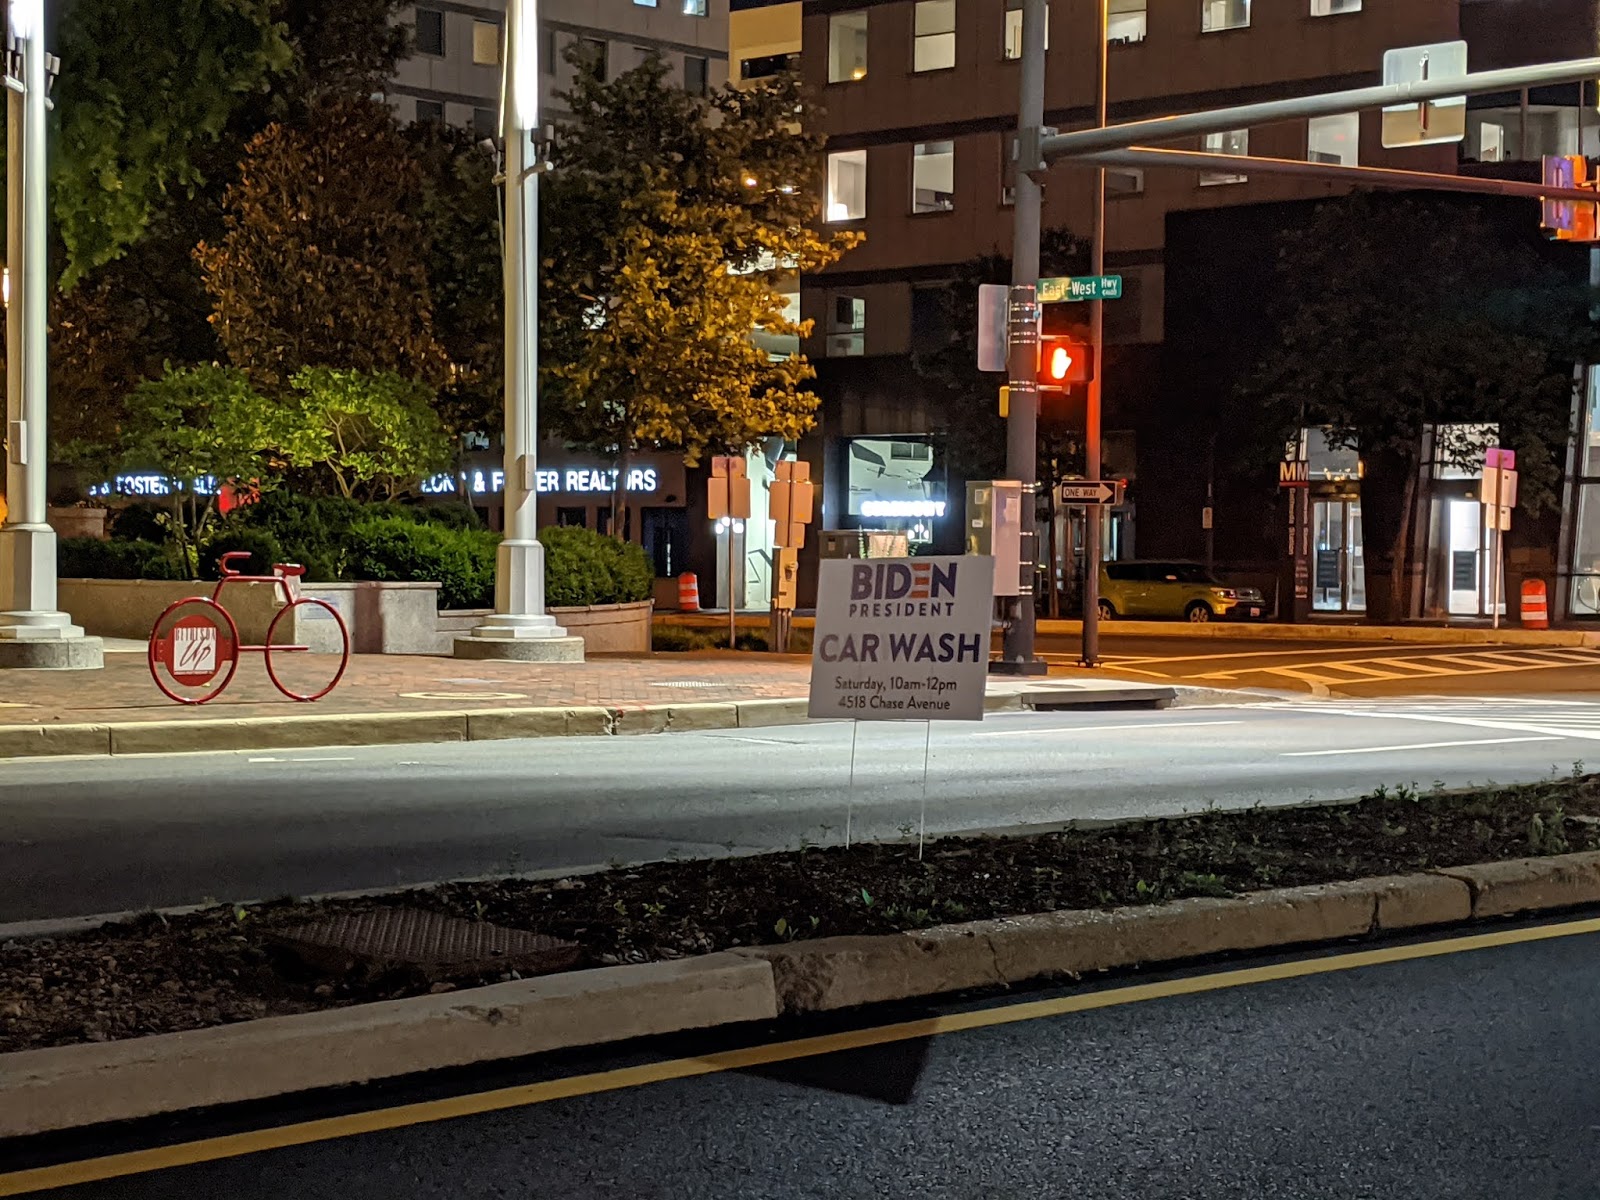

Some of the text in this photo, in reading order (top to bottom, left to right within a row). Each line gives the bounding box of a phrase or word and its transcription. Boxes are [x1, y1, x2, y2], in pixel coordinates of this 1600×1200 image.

[1101, 278, 1118, 289] Hwy
[473, 471, 486, 493] &
[565, 469, 657, 493] REALTRS
[1065, 488, 1097, 496] ONE WAY
[851, 563, 957, 600] BIDEN
[850, 602, 954, 617] PRESIDENT
[820, 633, 981, 663] CAR WASH
[835, 676, 957, 695] Saturday, 10am-12pm
[838, 695, 950, 710] 4518 Chase Avenue
